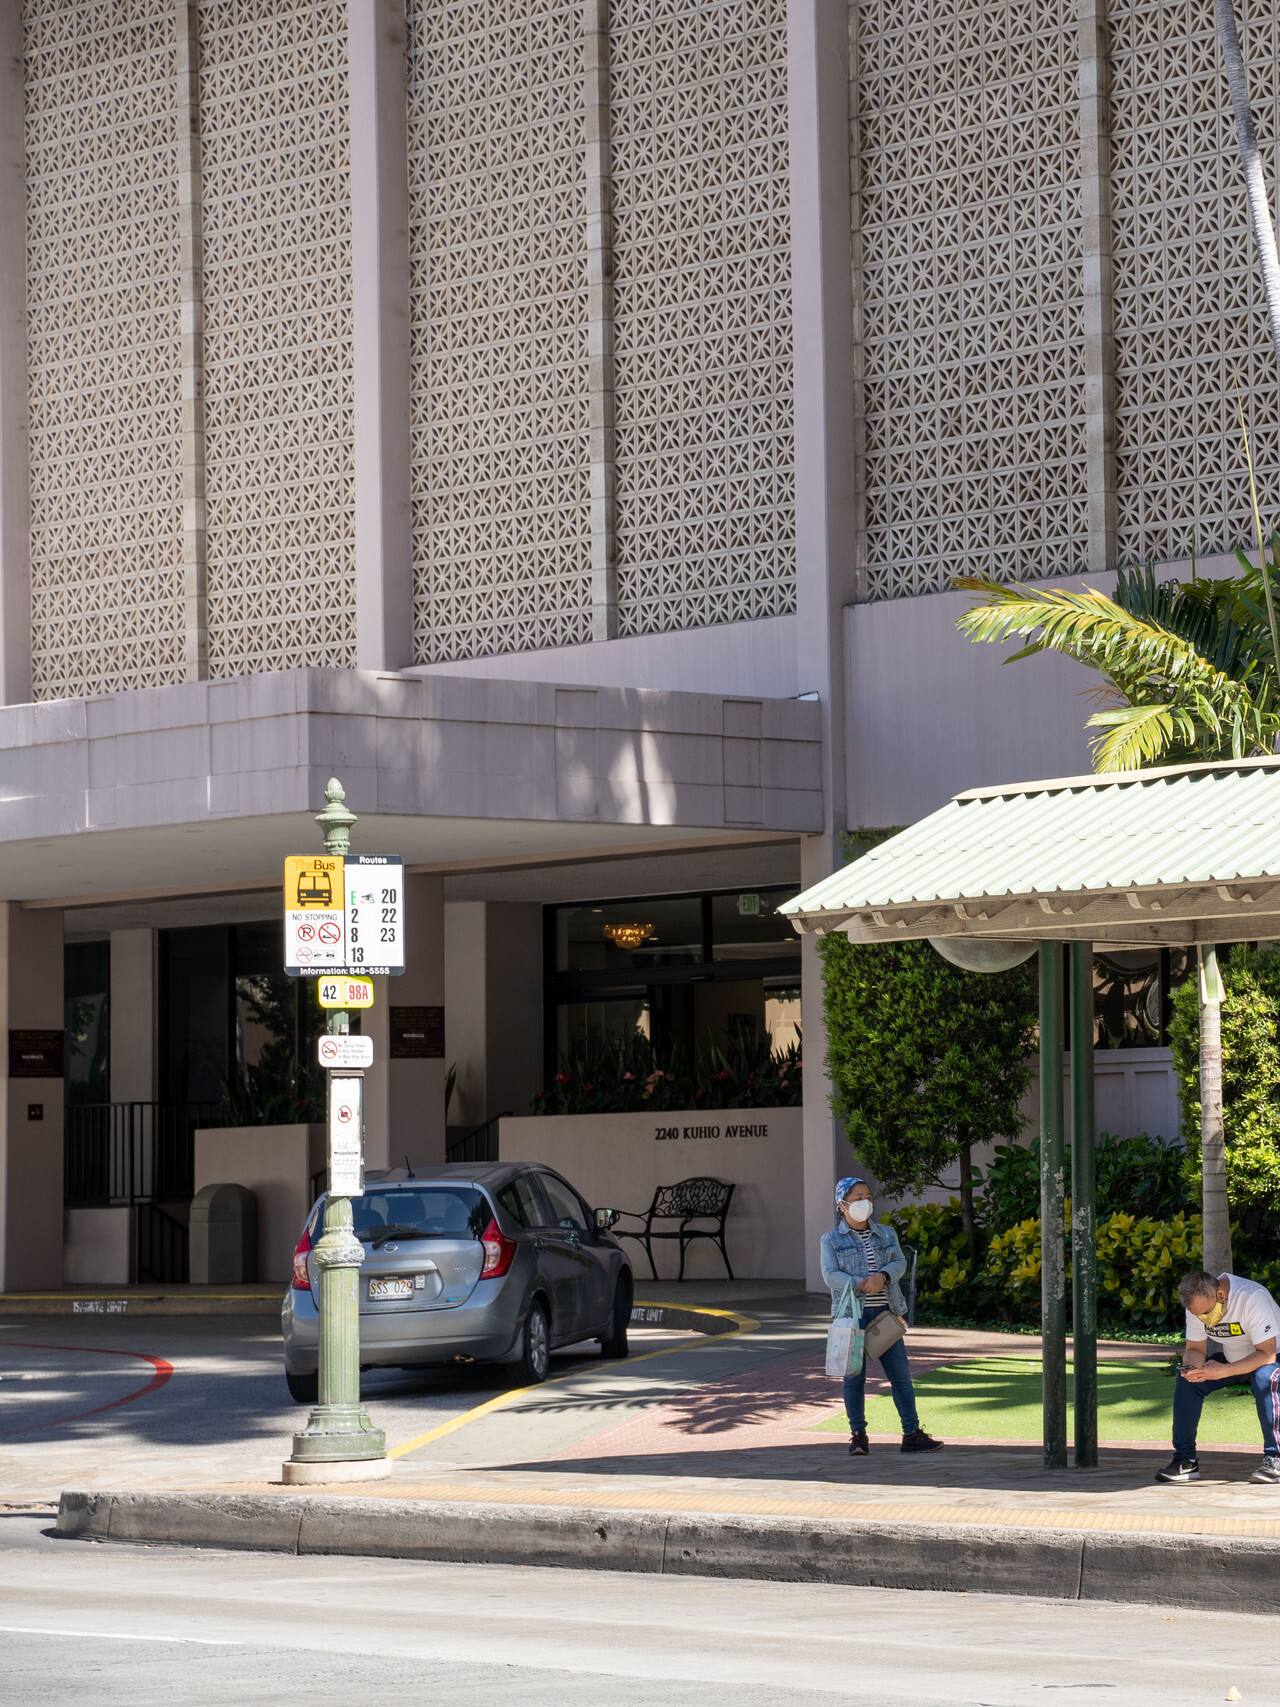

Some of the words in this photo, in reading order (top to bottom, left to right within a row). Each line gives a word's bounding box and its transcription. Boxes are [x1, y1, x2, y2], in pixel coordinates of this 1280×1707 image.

[359, 856, 388, 864] Routes
[350, 891, 357, 905] E
[381, 888, 397, 904] 20
[292, 913, 303, 921] NO
[305, 913, 338, 921] STOPPING
[351, 908, 359, 923] 2
[381, 908, 397, 923] 22
[350, 927, 359, 943] 8
[380, 927, 396, 943] 23
[351, 946, 364, 963] 13
[300, 967, 348, 975] Information:
[349, 967, 390, 975] 848-5555
[322, 985, 337, 1000] 42
[348, 984, 369, 1000] 98A
[654, 1127, 679, 1140] 2240
[682, 1126, 720, 1139] KUHIO
[725, 1124, 769, 1138] AVENUE
[370, 1282, 388, 1295] SSS
[394, 1280, 413, 1293] 029
